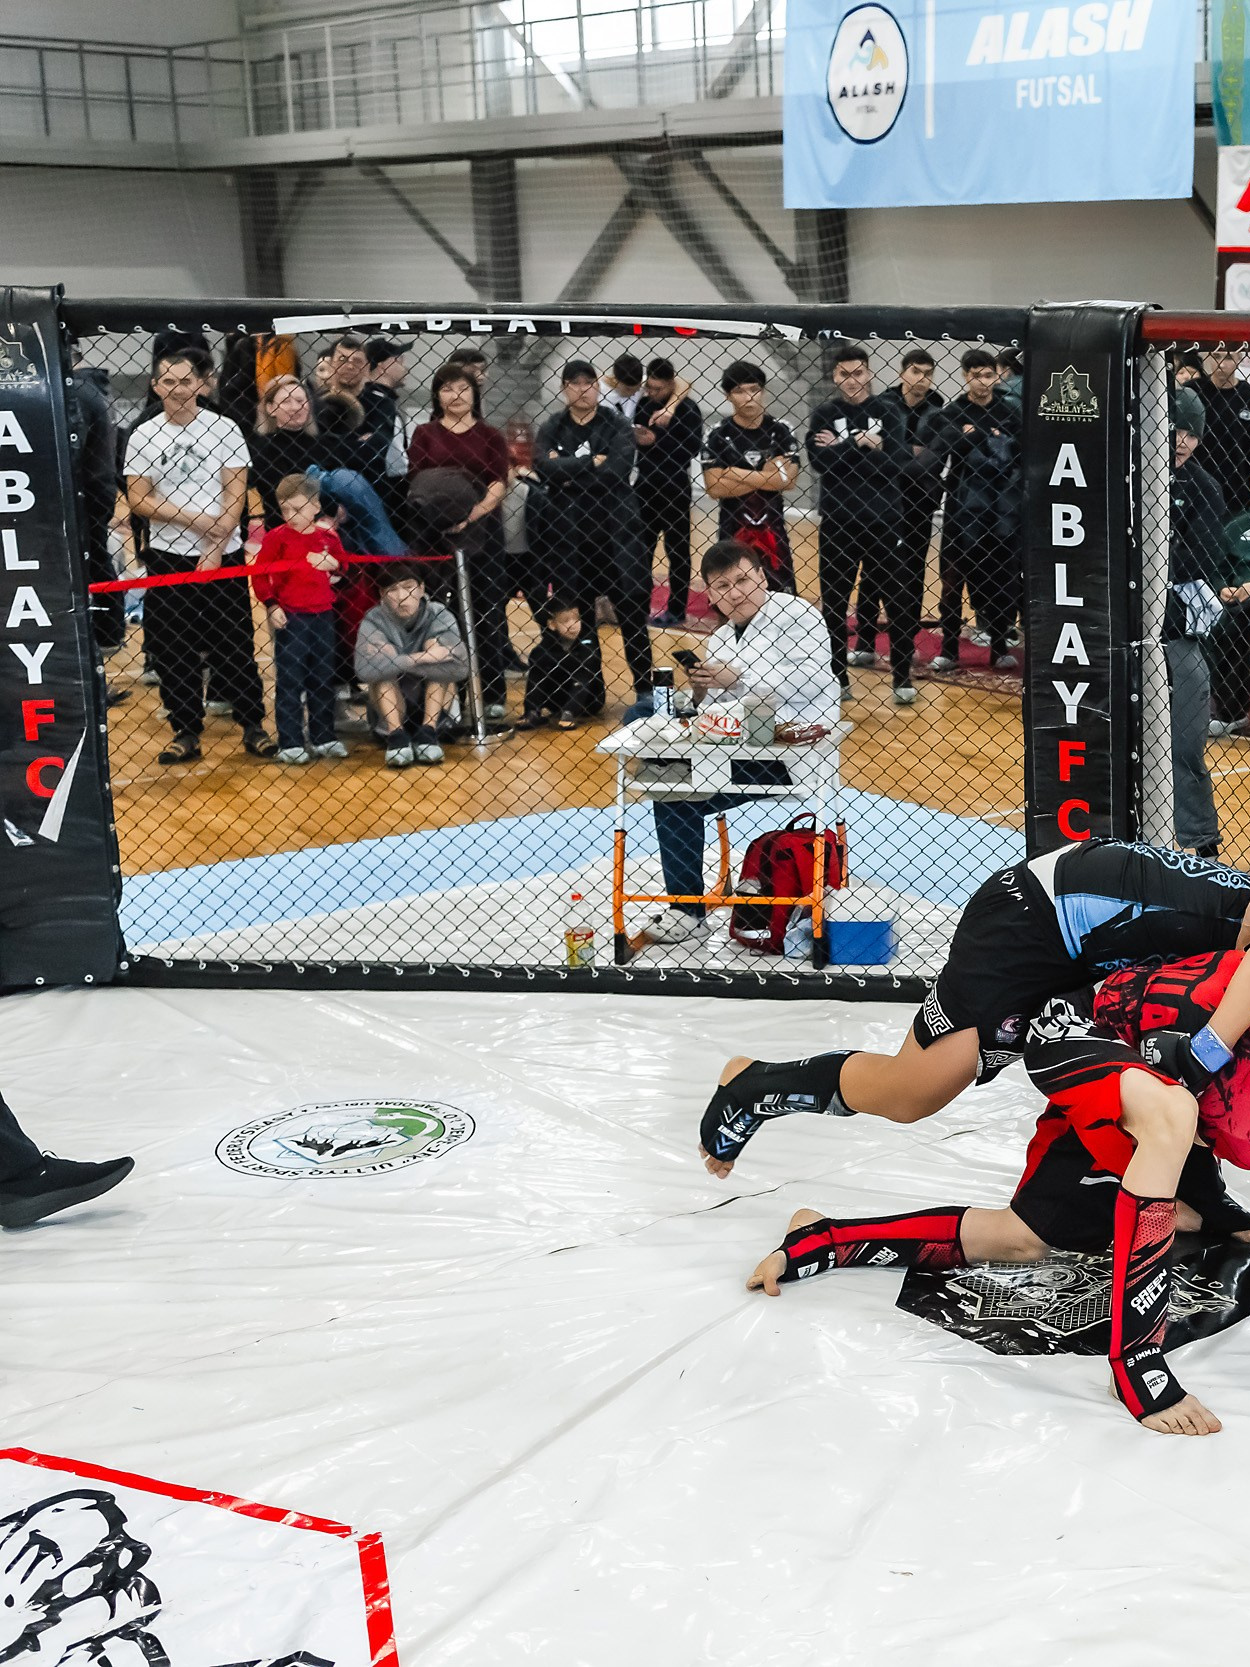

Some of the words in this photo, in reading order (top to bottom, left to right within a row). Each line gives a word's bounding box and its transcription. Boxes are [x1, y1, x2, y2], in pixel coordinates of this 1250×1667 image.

[965, 0, 1154, 66] ALASH
[838, 82, 895, 99] ALASH
[1015, 74, 1102, 110] FUTSAL
[1048, 442, 1091, 725] ABLAY
[1056, 740, 1092, 842] FC
[1130, 1268, 1168, 1309] GREEN
[1135, 1282, 1168, 1316] HILL
[1148, 1376, 1166, 1389] HILL
